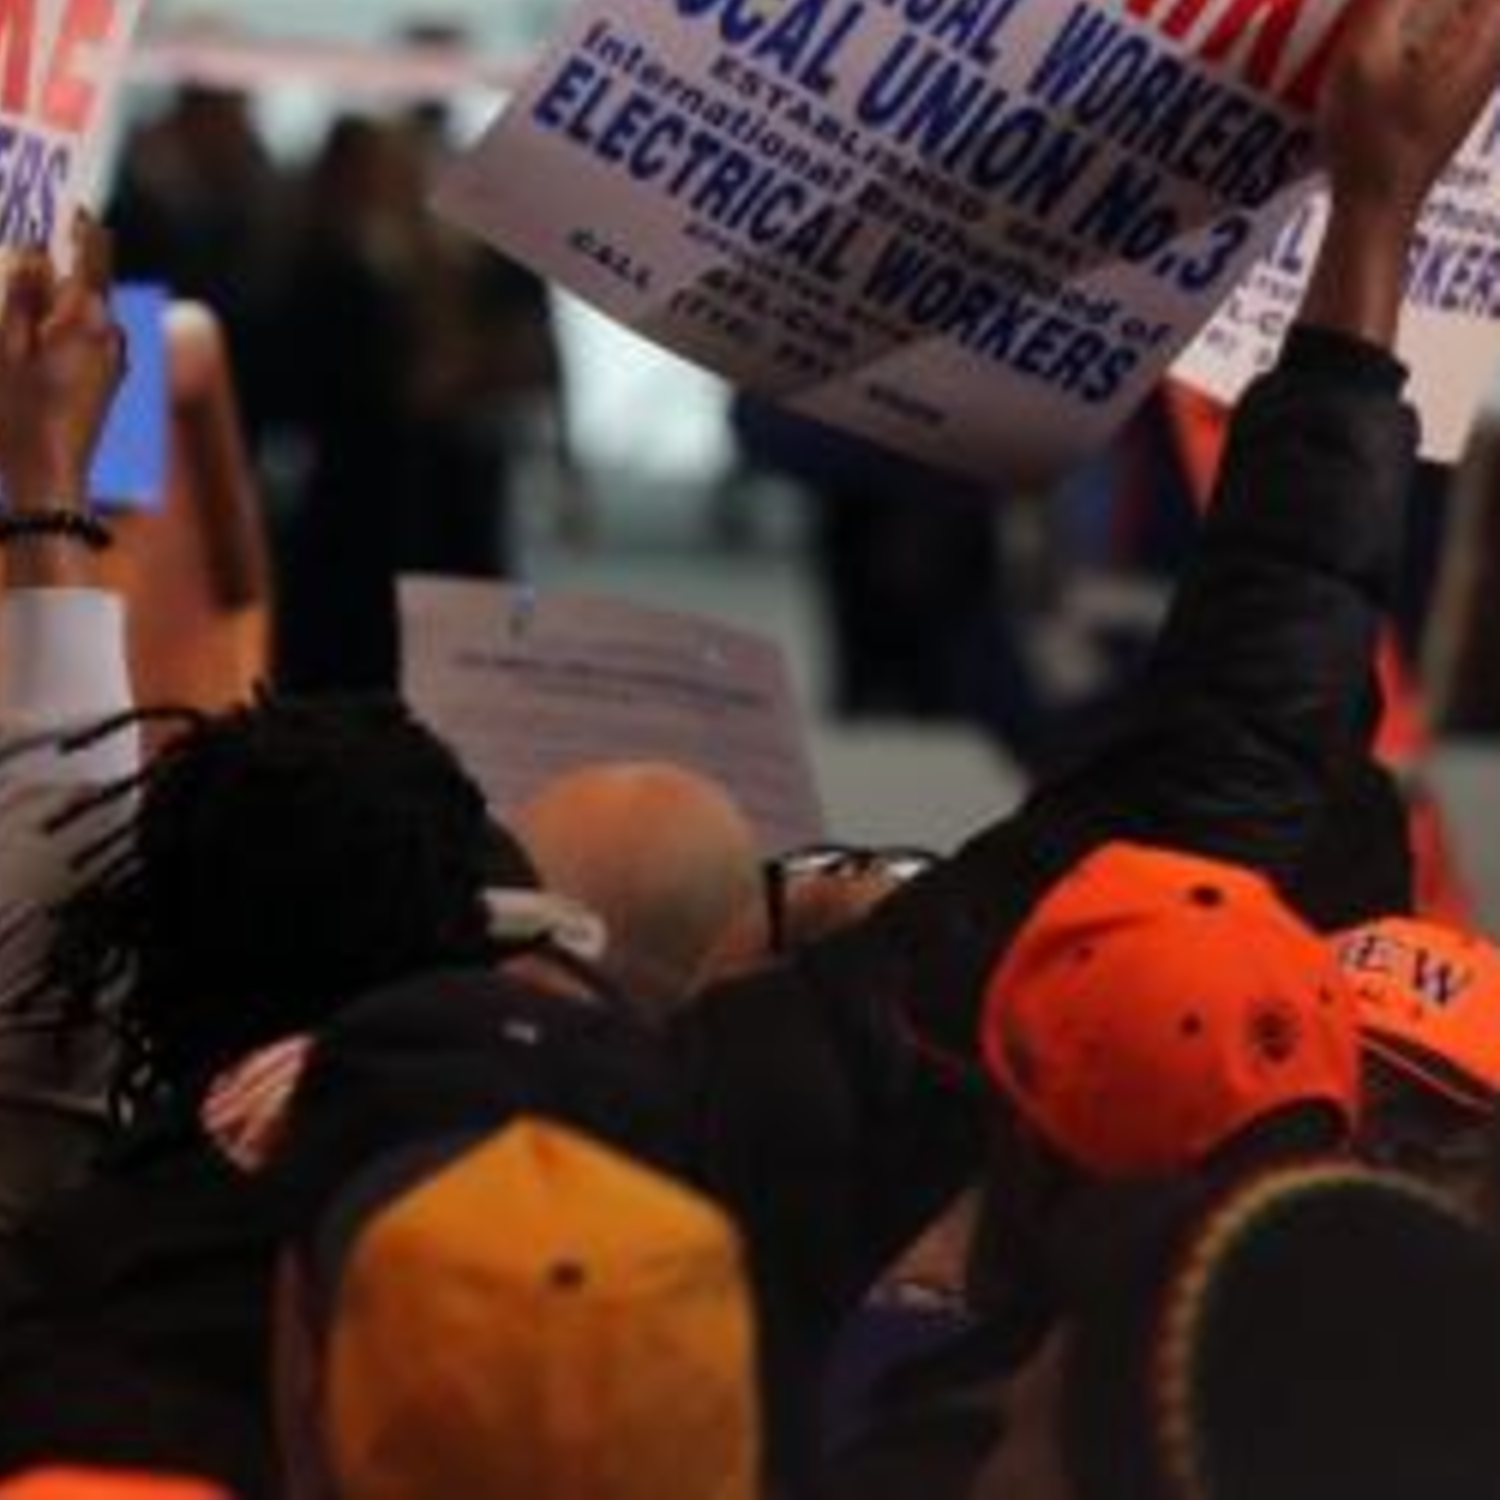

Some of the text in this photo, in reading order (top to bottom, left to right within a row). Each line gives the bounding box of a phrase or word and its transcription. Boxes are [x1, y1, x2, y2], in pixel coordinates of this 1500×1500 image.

[532, 57, 864, 284] ELECTRICAL
[862, 232, 1142, 404] WORKERS
[581, 18, 853, 194] International
[1120, 312, 1174, 346] of
[855, 35, 1098, 214] UNION
[1074, 160, 1253, 293] No.3
[1027, 2, 1318, 210] WORKERS
